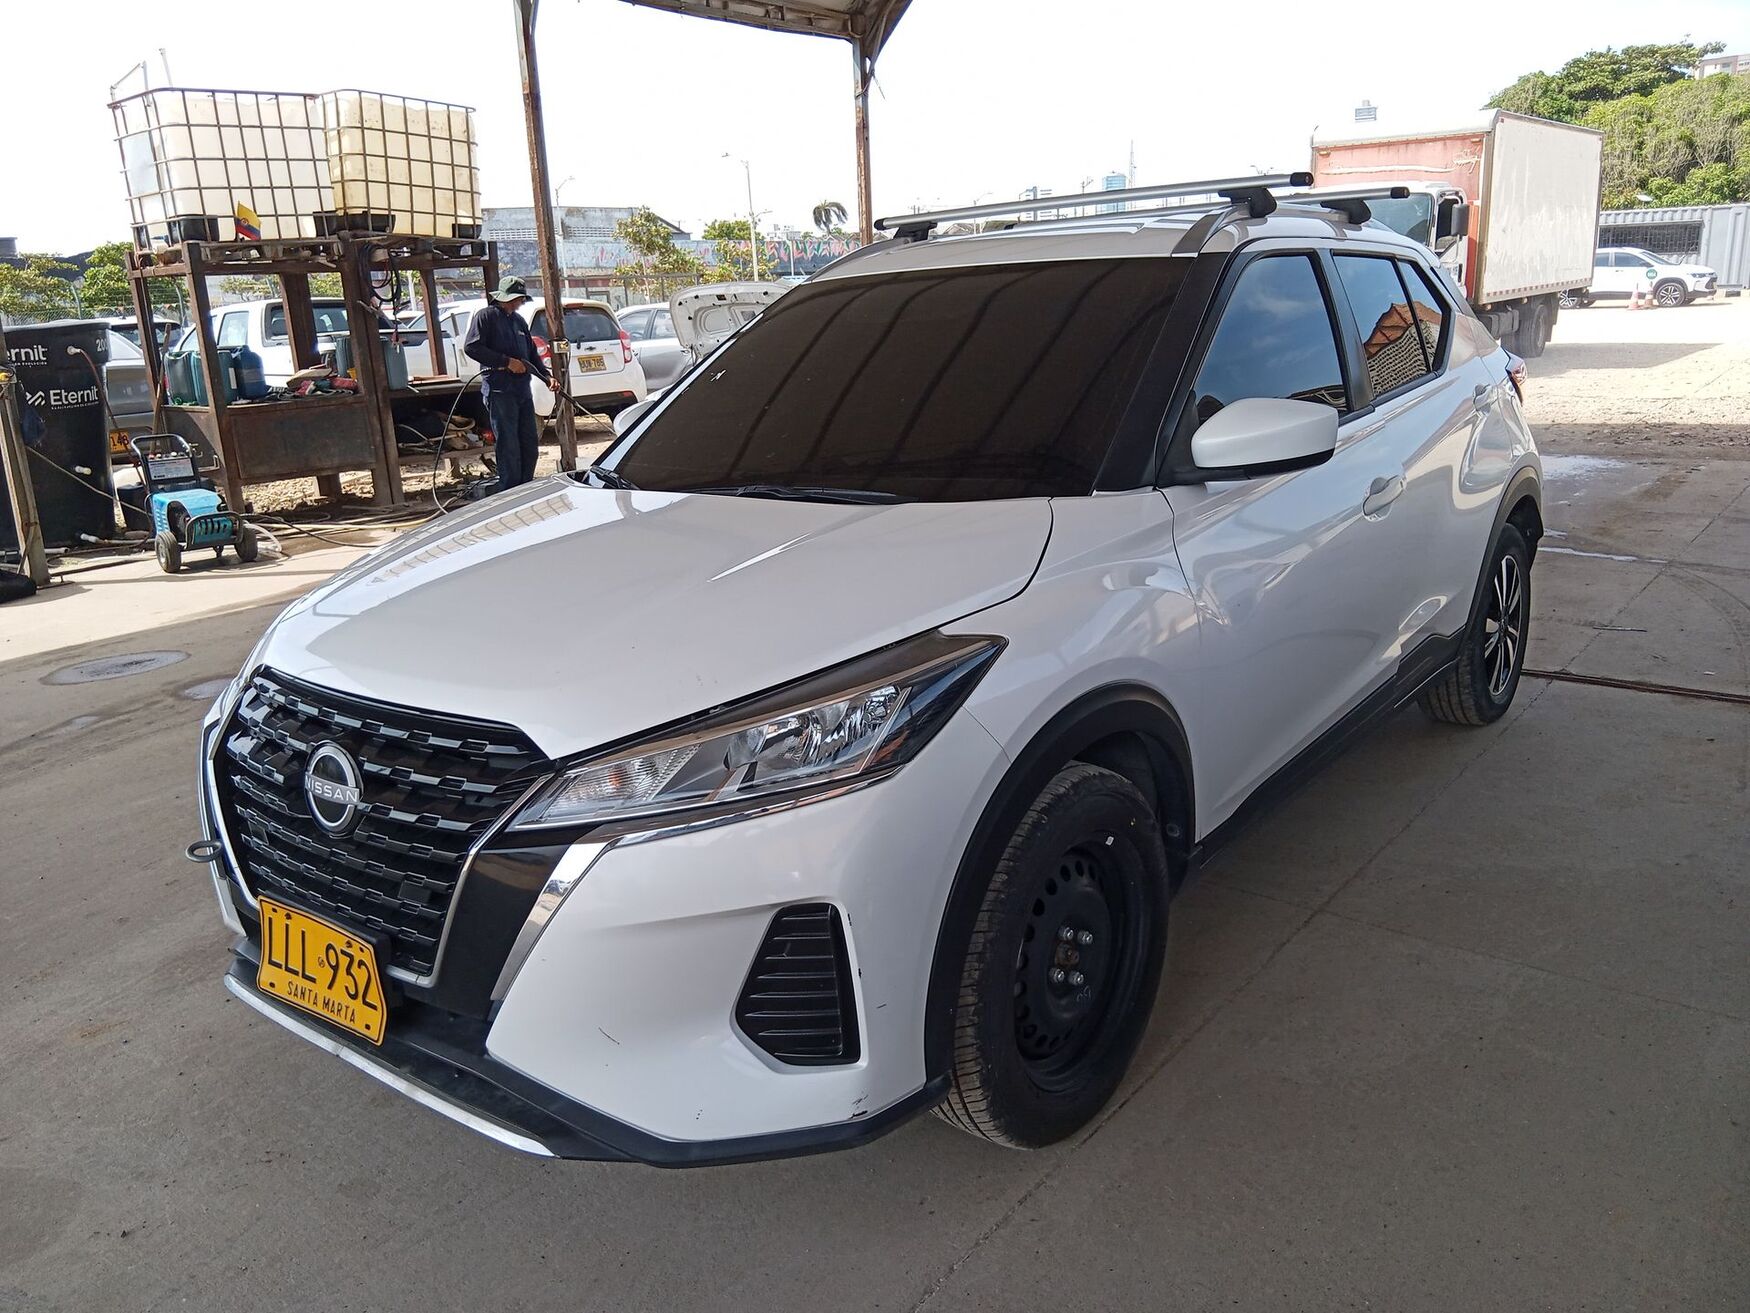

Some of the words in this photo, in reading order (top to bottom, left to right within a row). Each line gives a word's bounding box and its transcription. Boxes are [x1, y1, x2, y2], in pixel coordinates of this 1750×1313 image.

[49, 386, 99, 405] Eternit
[304, 774, 358, 802] NISSAN
[268, 916, 317, 984] LLL
[325, 943, 378, 1011] 932
[287, 980, 318, 1006] SANTA
[322, 995, 356, 1023] MARTA
